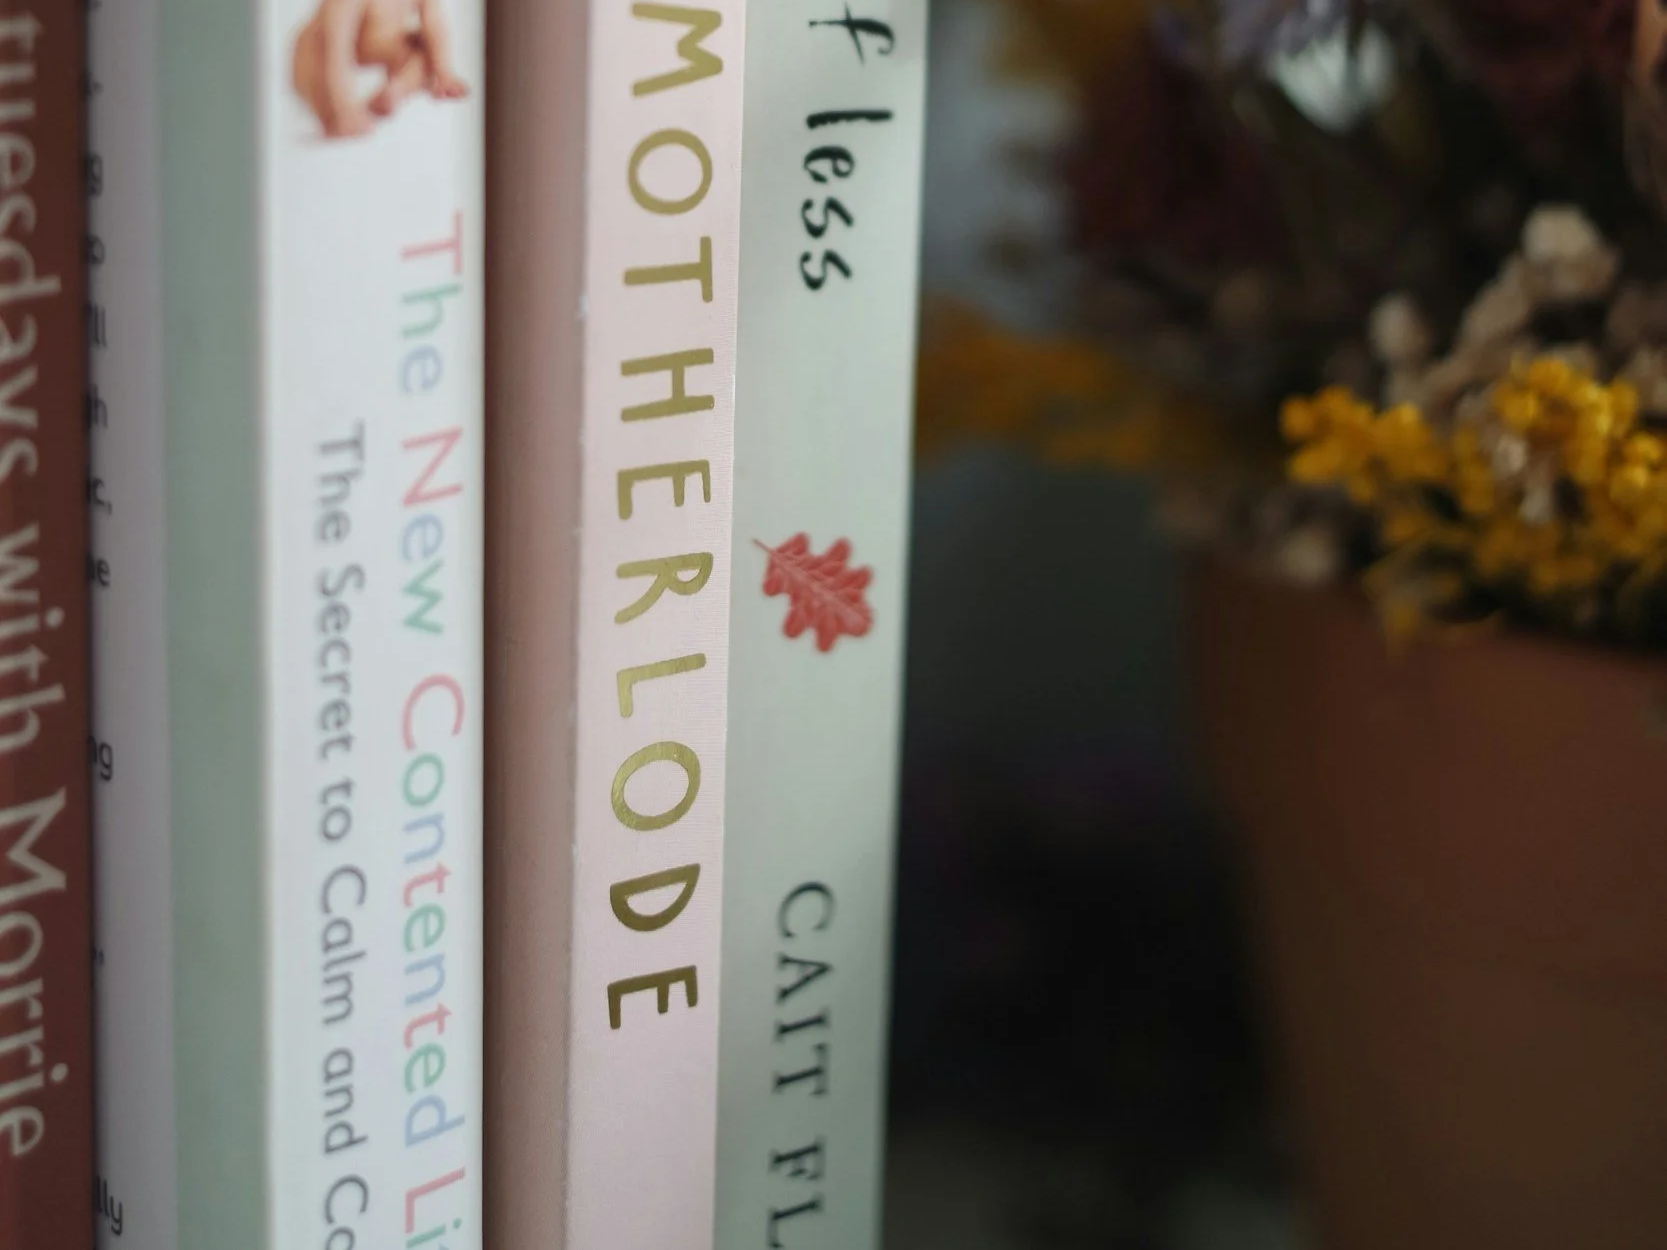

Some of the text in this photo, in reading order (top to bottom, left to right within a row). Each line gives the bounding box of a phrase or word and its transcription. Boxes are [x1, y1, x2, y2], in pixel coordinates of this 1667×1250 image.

[799, 106, 894, 293] less
[316, 418, 367, 544] The
[606, 0, 724, 1031] MOTHERLODE
[0, 521, 66, 749] with
[315, 560, 368, 762] Secret
[400, 208, 467, 1250] The New Contented Li
[319, 775, 356, 844] to
[0, 786, 68, 1158] Morrie
[320, 863, 367, 1027] Calm
[771, 880, 835, 1098] CAIT
[322, 1047, 368, 1155] and
